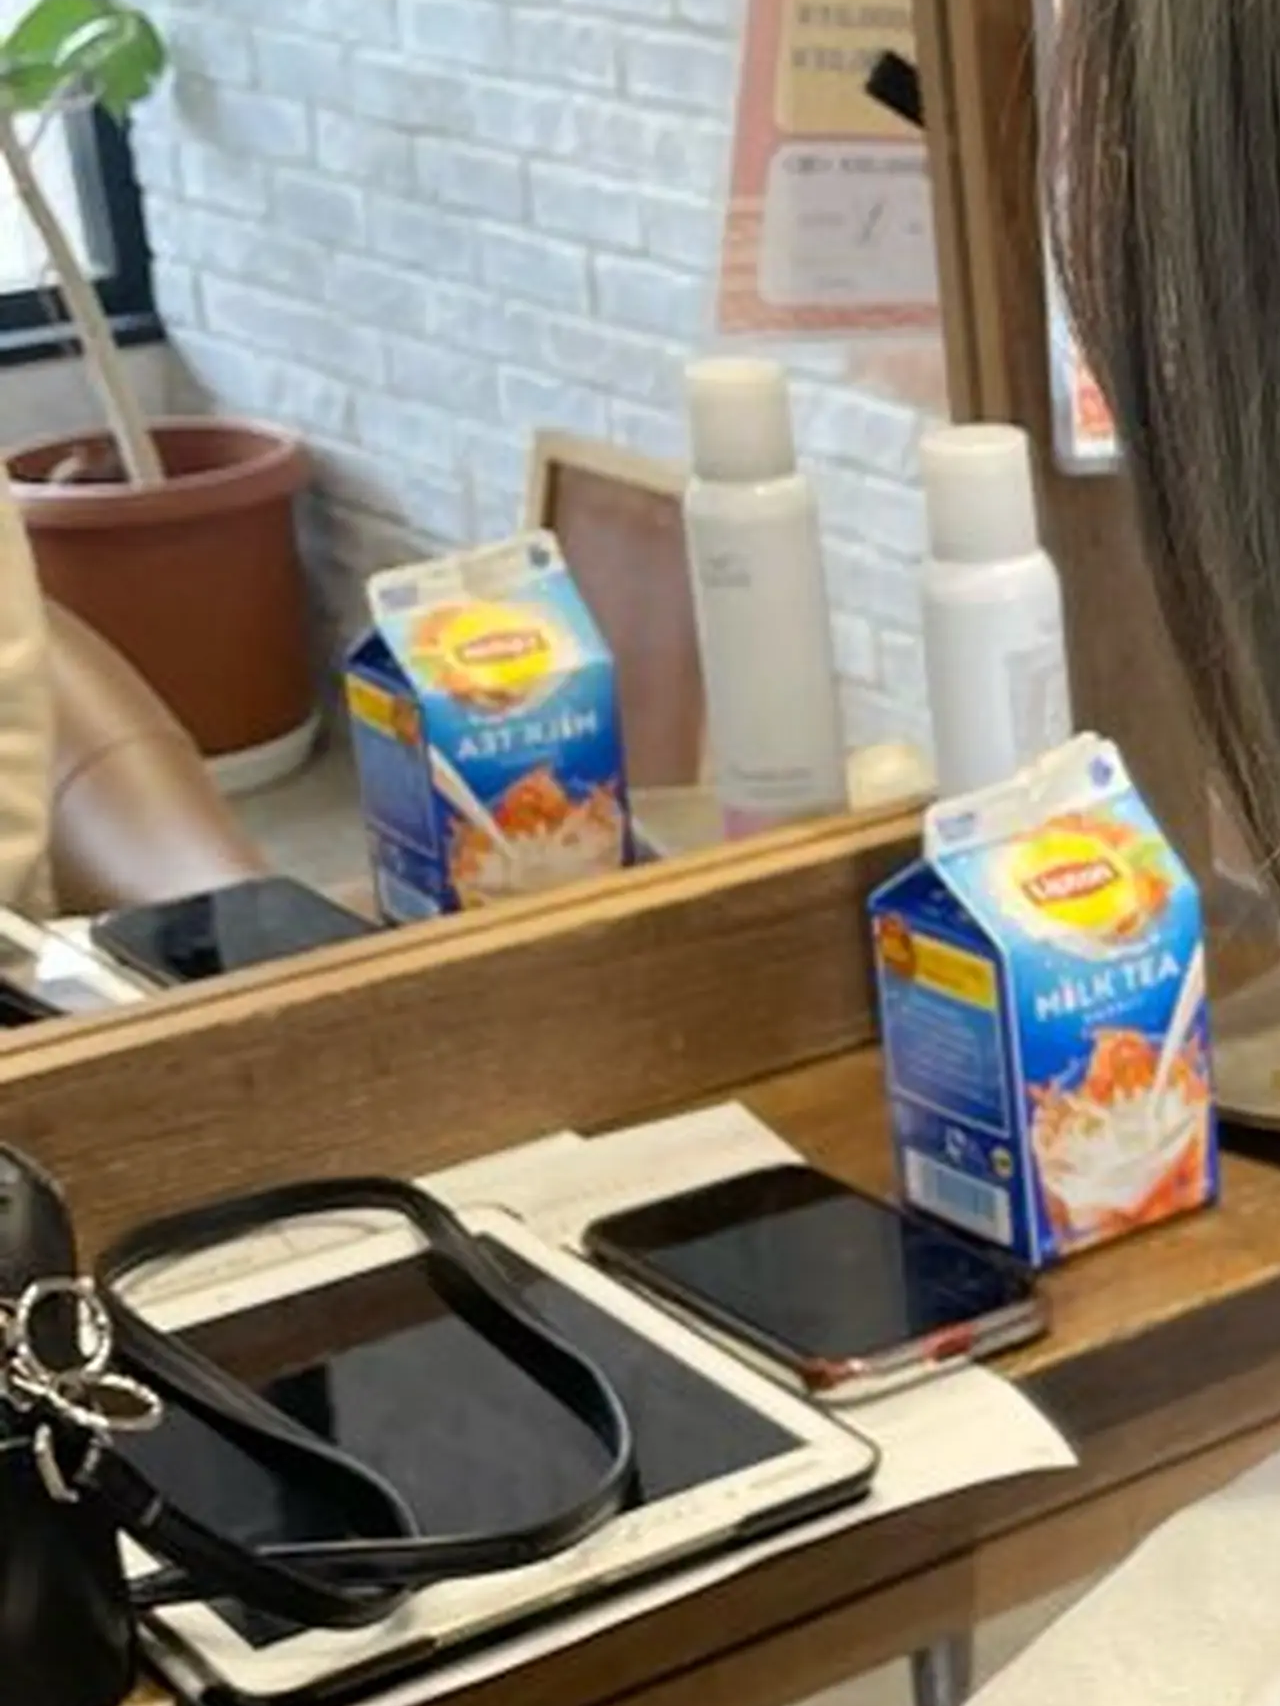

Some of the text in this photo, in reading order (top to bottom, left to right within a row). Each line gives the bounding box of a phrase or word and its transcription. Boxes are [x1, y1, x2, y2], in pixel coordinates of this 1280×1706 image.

[1029, 861, 1114, 901] Lipton
[1035, 965, 1115, 1022] MILK
[1121, 950, 1180, 991] TEA
